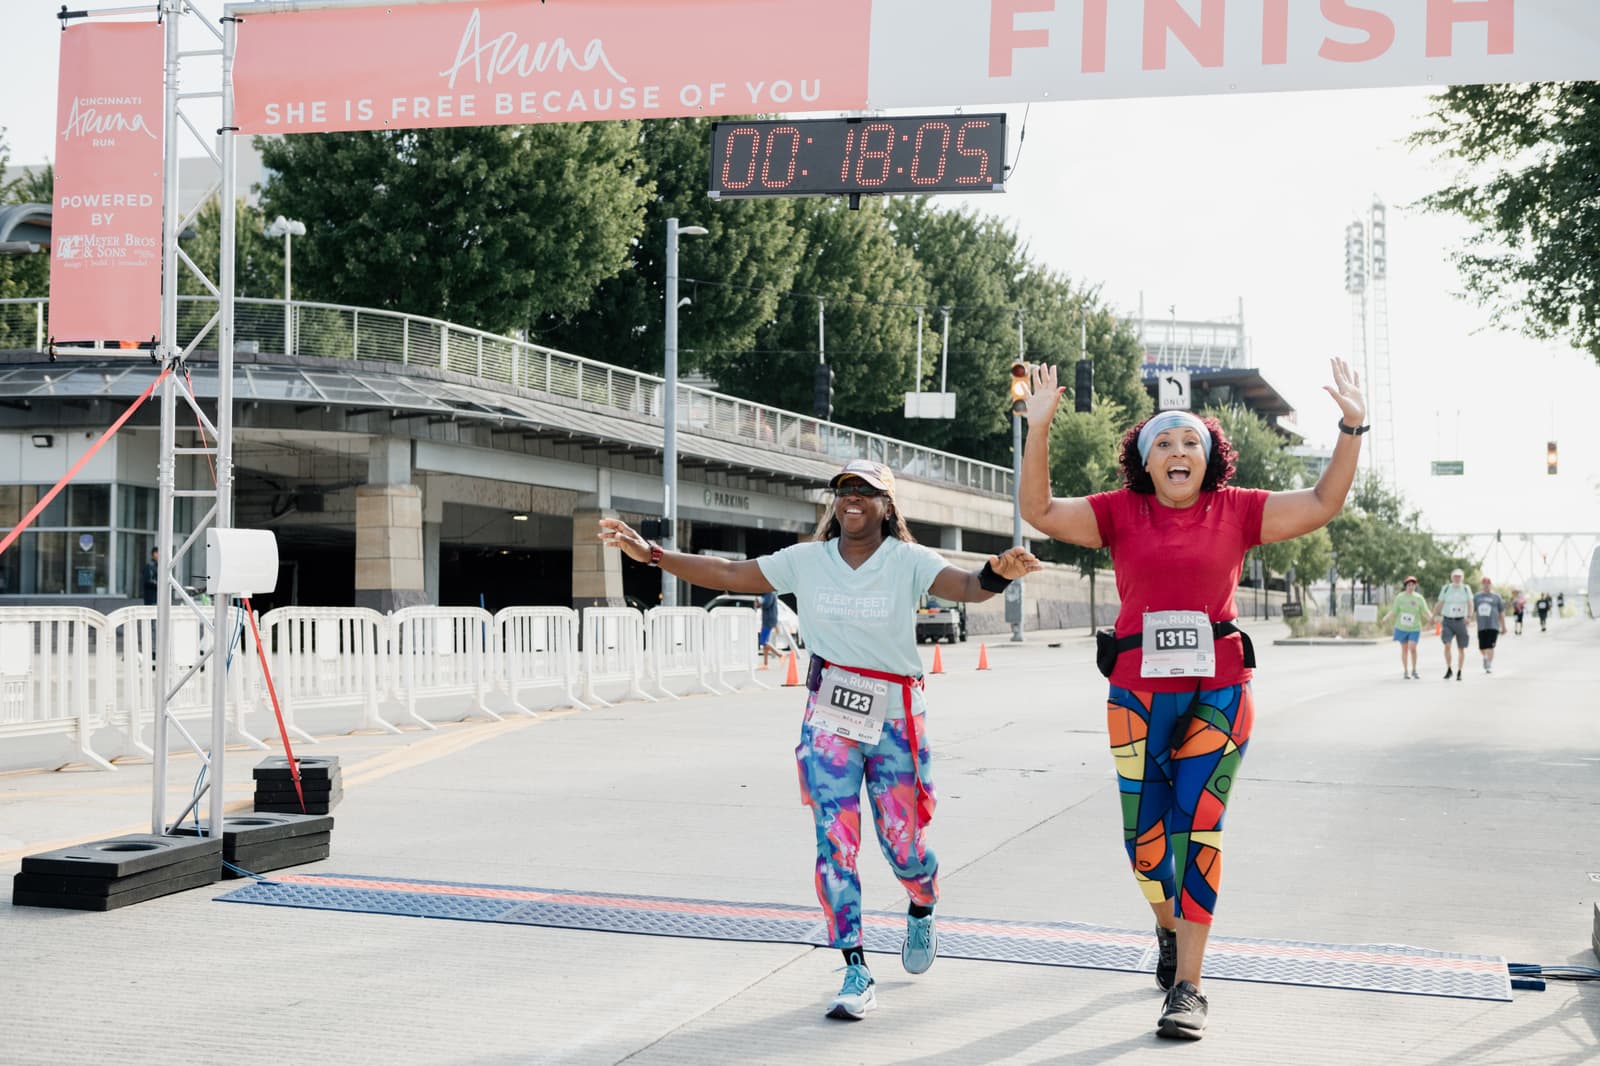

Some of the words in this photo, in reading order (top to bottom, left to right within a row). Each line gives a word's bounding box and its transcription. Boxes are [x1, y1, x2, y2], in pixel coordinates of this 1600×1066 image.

[988, 0, 1514, 78] FINISH
[439, 8, 628, 89] Aruna
[80, 97, 142, 106] CINCINNATI
[264, 101, 328, 125] SHE
[345, 99, 374, 121] IS
[391, 94, 476, 120] FREE
[495, 86, 660, 116] BECAUSE
[680, 83, 727, 107] OF
[745, 79, 821, 104] YOU
[92, 138, 116, 147] RUN
[61, 193, 154, 209] POWERED
[91, 213, 114, 226] BY
[84, 247, 93, 258] &
[714, 492, 750, 510] PARKING
[856, 596, 888, 608] FEET
[862, 608, 888, 618] Club
[1169, 615, 1194, 625] RUN
[1157, 630, 1197, 647] 1315
[850, 676, 874, 690] RUN
[834, 688, 872, 712] 1123
